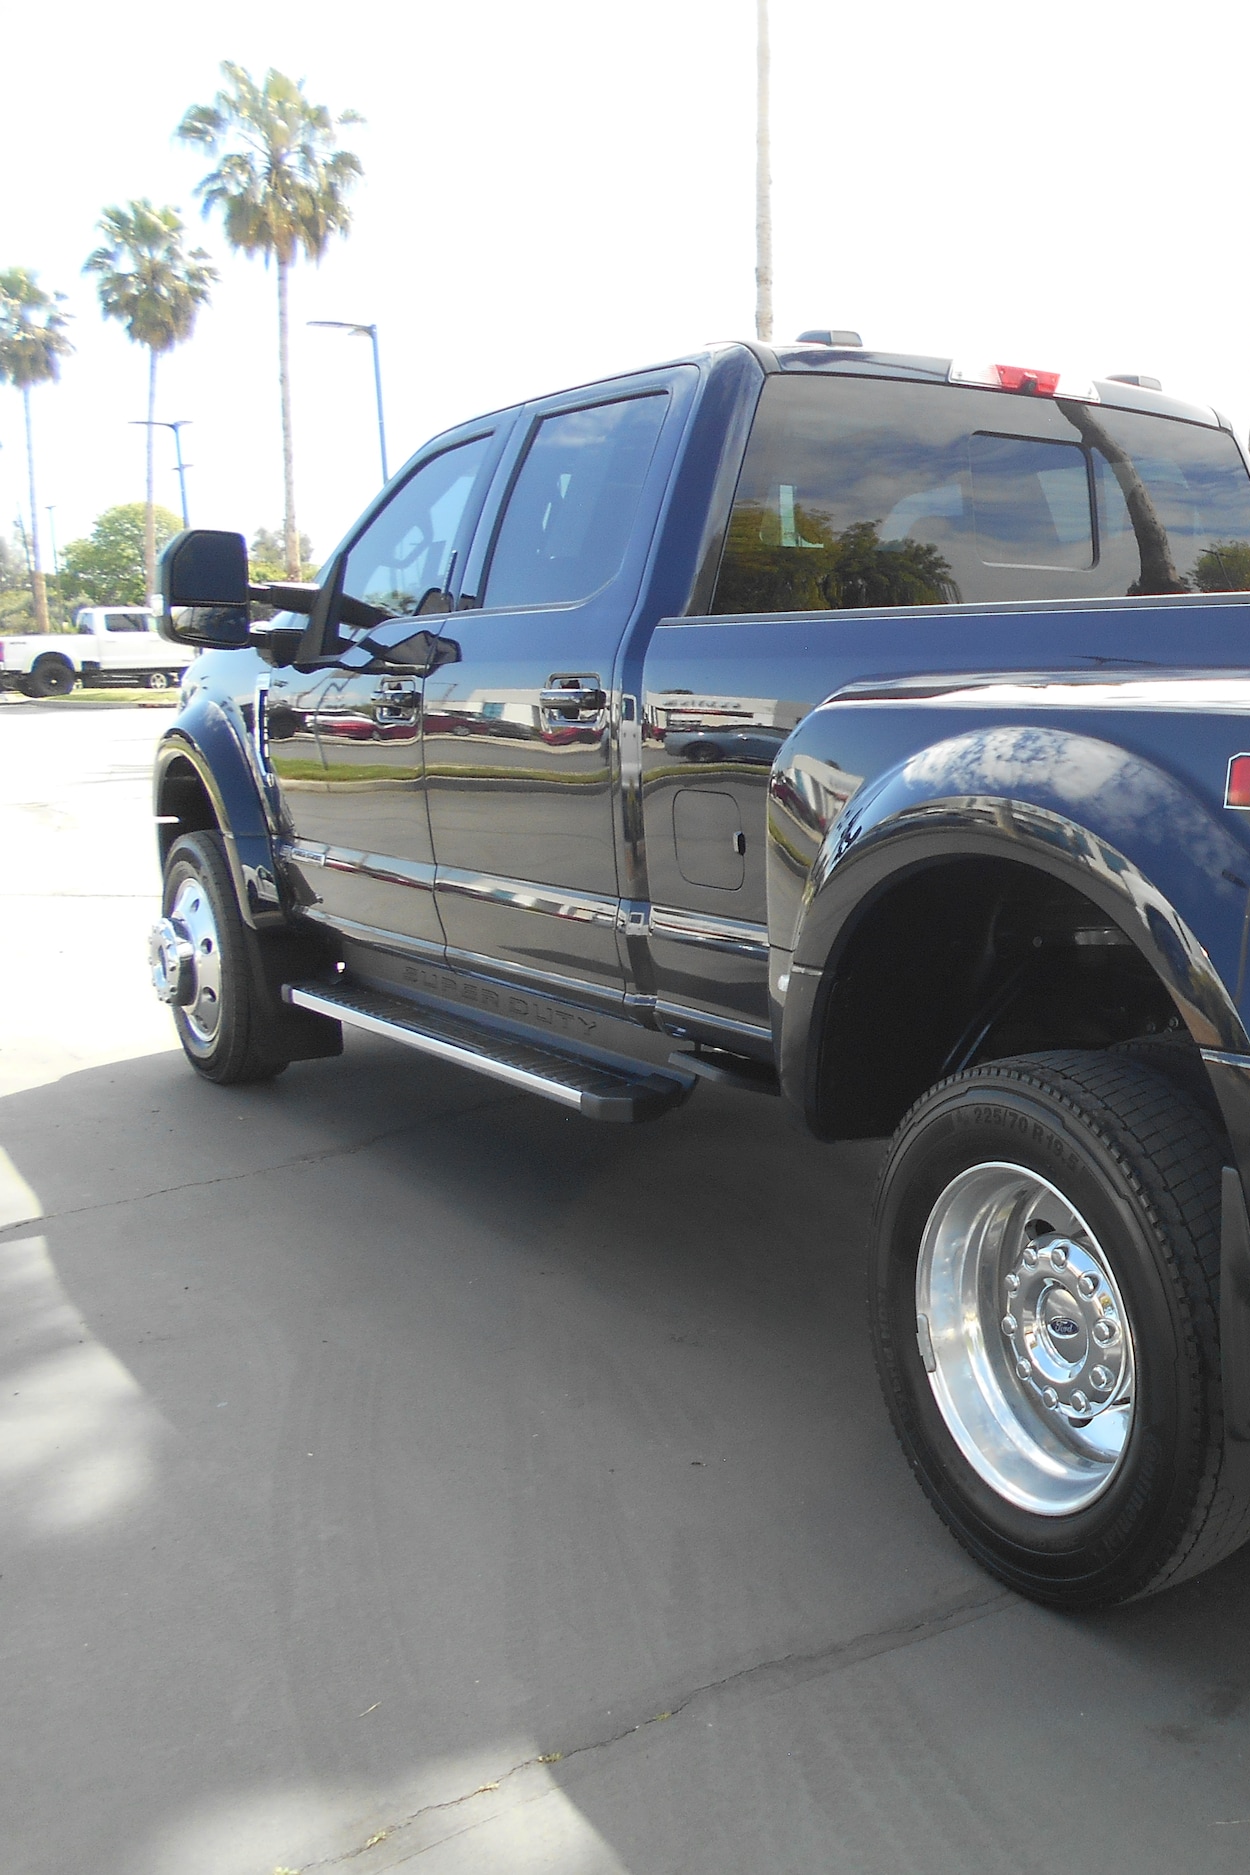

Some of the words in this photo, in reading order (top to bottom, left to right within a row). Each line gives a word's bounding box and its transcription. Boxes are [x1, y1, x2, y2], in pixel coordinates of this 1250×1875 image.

[403, 965, 500, 1008] SUPER
[508, 996, 597, 1036] DUTY
[973, 1105, 1029, 1134] 225/70
[1053, 1319, 1076, 1334] Ford
